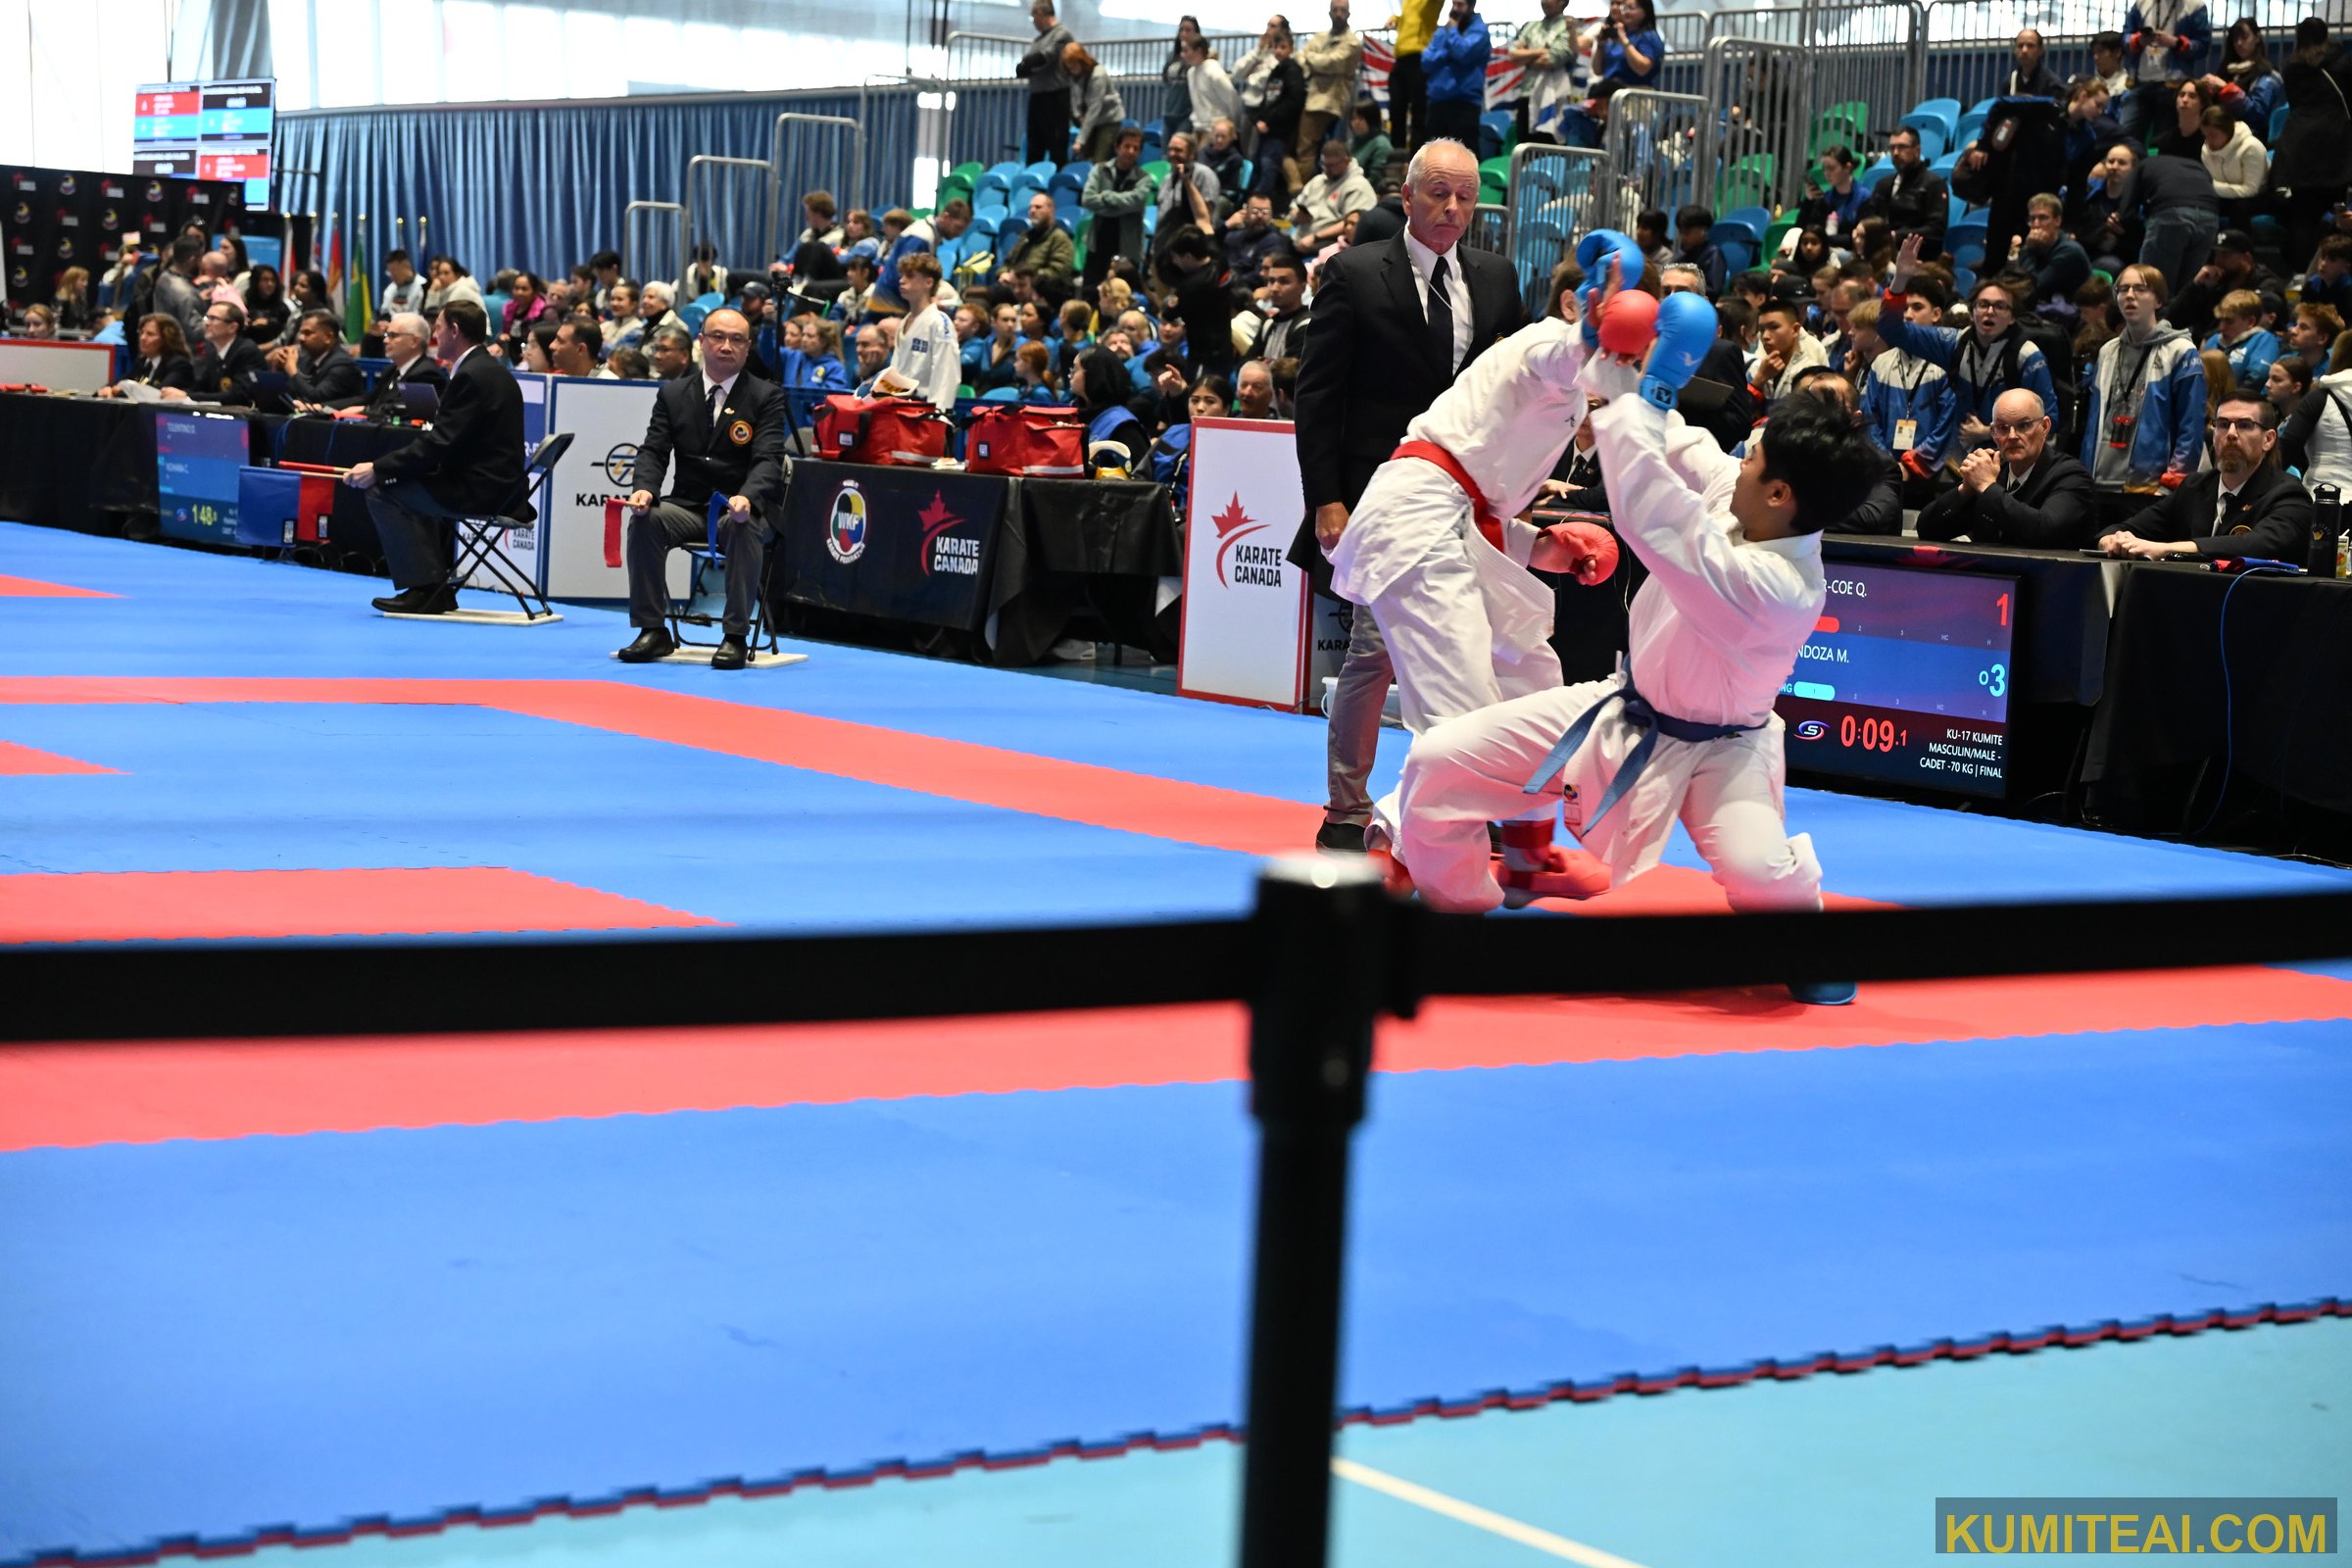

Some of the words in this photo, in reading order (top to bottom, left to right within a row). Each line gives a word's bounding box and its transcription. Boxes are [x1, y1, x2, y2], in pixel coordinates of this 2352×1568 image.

[838, 512, 860, 531] WKF
[936, 536, 980, 558] KARATE
[1236, 544, 1282, 567] KARATE
[934, 555, 979, 575] CANADA
[1235, 564, 1281, 588] CANADA
[1855, 582, 1867, 598] Q.
[1996, 593, 2009, 626] 1
[1837, 648, 1849, 663] M.
[1946, 728, 1971, 741] KU-17
[1972, 731, 2003, 745] KUMITE
[1929, 742, 1996, 760] MASCULIN/MALE
[1920, 758, 1946, 770] CADET
[1947, 761, 1961, 772] -70
[1962, 762, 1974, 774] KG
[1980, 765, 2003, 778] FINAL
